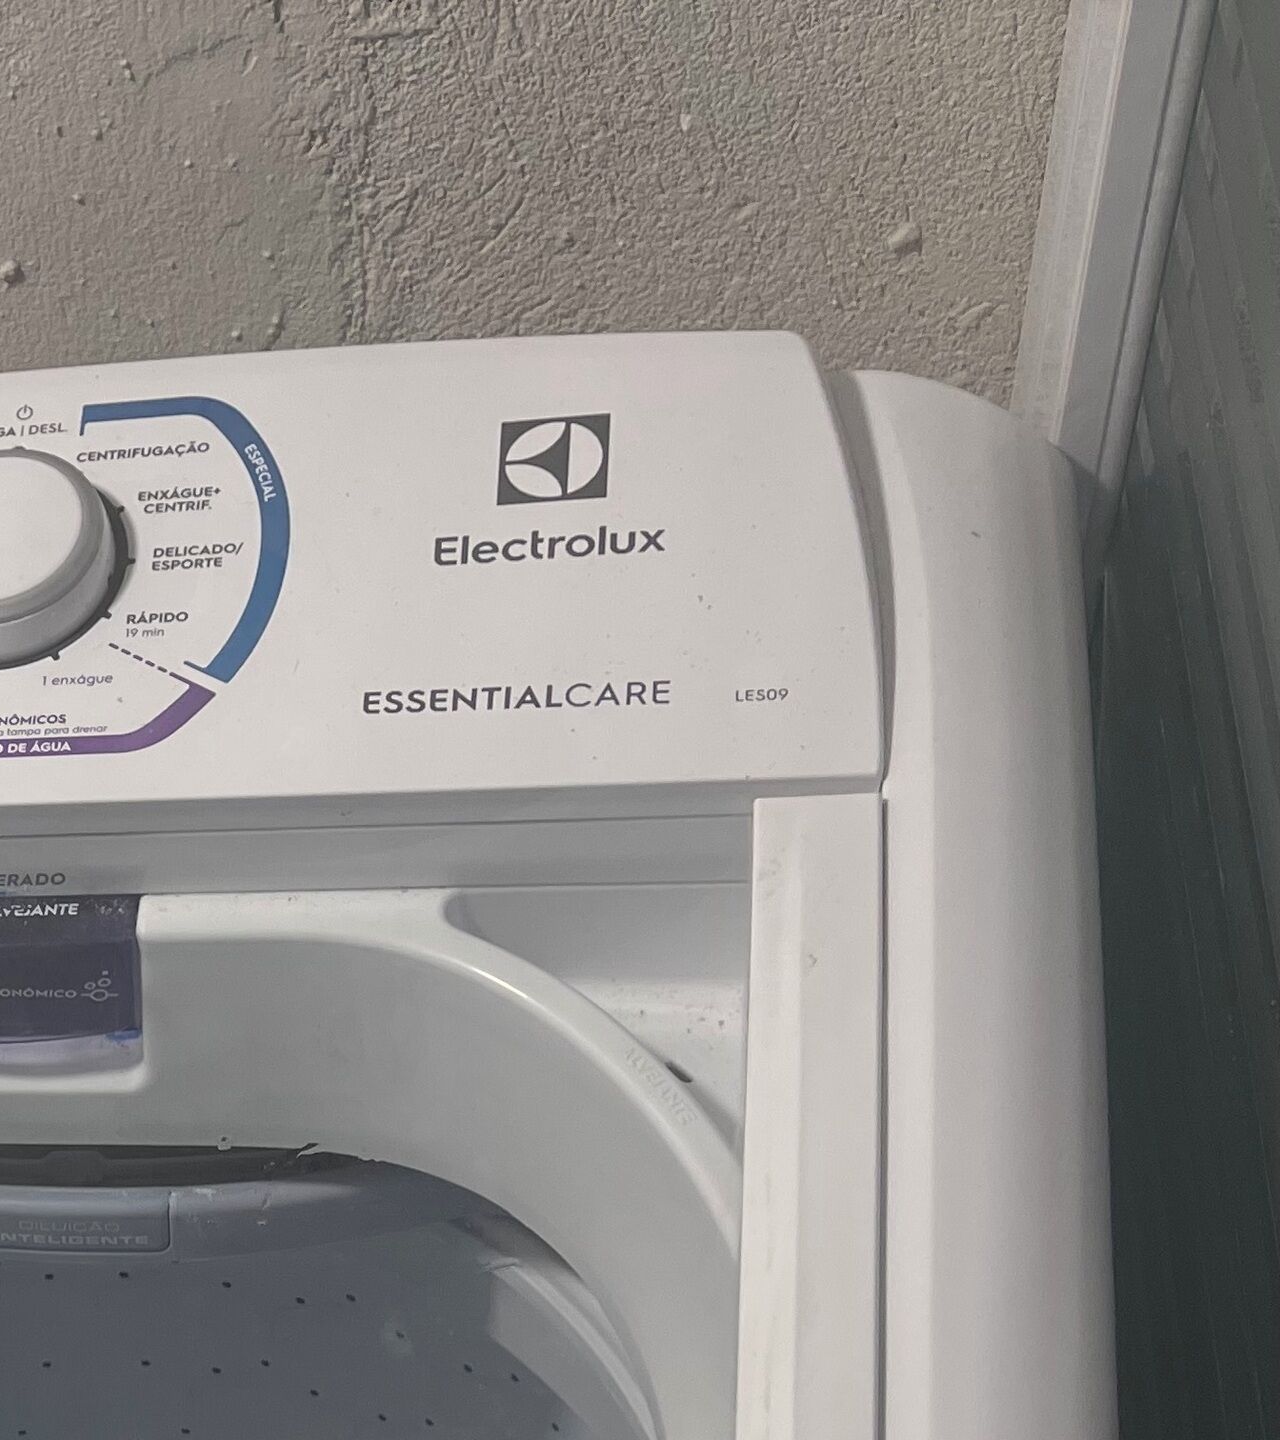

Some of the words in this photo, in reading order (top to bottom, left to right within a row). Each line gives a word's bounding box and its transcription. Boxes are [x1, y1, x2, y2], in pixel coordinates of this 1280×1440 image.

[28, 422, 69, 436] DESL.
[76, 441, 210, 463] CENTRIFUGAÇÃO
[244, 442, 277, 503] ESPECIAL
[138, 486, 222, 502] ENXÁGUE+
[143, 500, 213, 514] CENTRIF.
[152, 542, 244, 559] DELICADO/
[433, 524, 667, 567] Electrolux
[151, 557, 223, 572] ESPORTE
[126, 610, 189, 625] RÁPIDO
[125, 627, 139, 638] 19
[141, 626, 165, 638] min
[42, 676, 48, 687] 1
[51, 673, 114, 688] enxágue
[362, 680, 672, 715] ESSENTIALCARE
[735, 687, 789, 703] LES09
[6, 726, 41, 738] tampa
[43, 727, 69, 737] para
[71, 724, 109, 735] drenar
[7, 742, 27, 754] DE
[29, 740, 71, 754] ÁGUA
